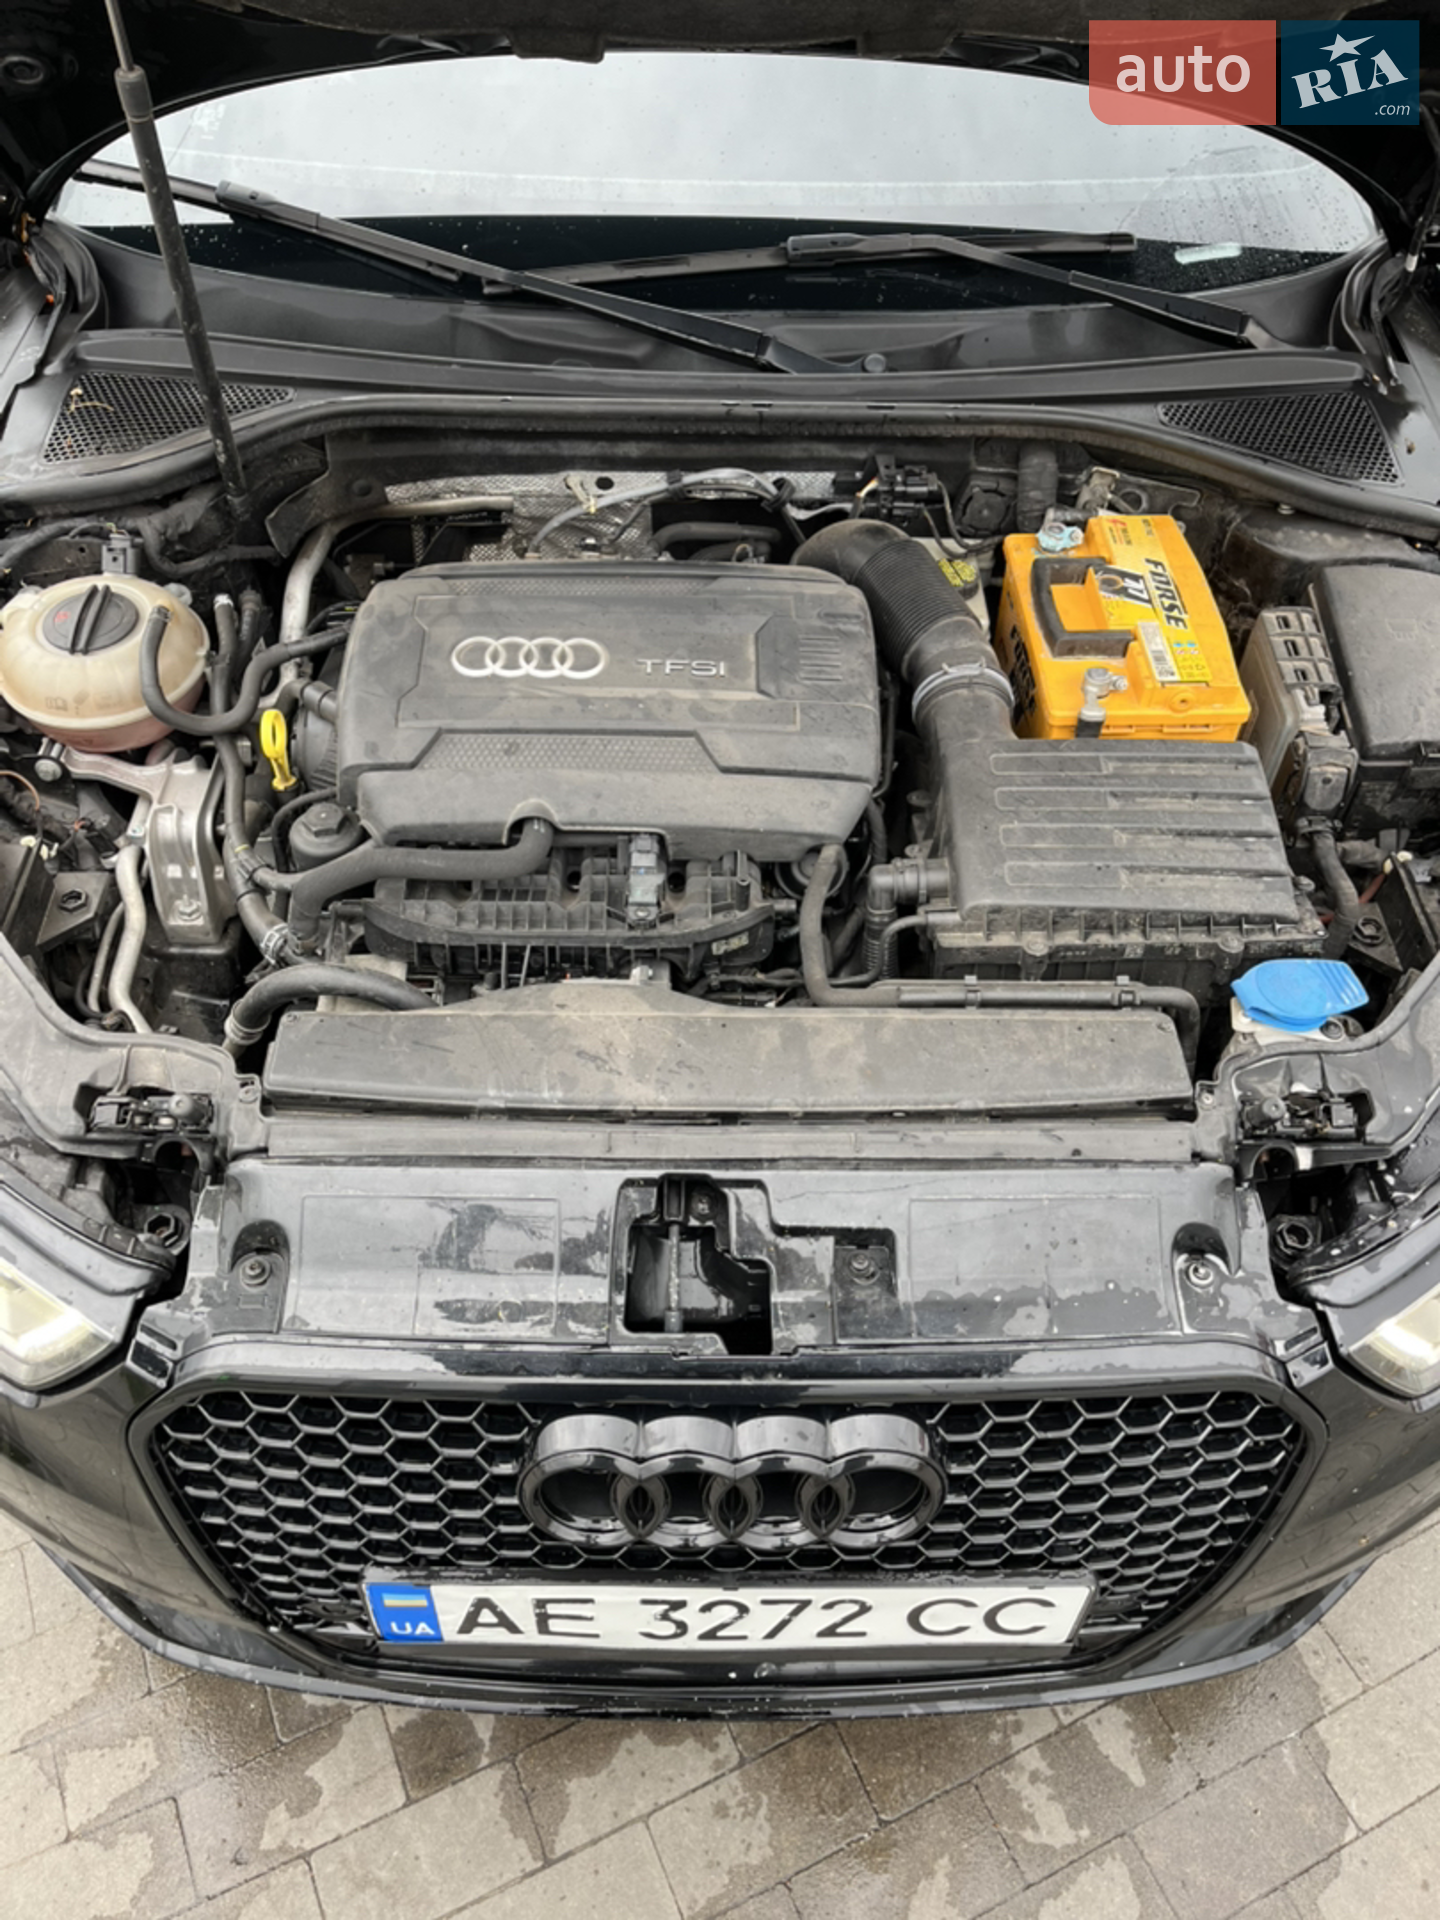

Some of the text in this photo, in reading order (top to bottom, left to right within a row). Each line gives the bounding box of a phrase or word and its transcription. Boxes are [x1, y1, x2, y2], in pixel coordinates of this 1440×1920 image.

[1144, 558, 1189, 629] FORSE
[637, 659, 725, 677] TFSI
[390, 1621, 435, 1636] UA
[456, 1597, 1057, 1641] AE 3272 CC
